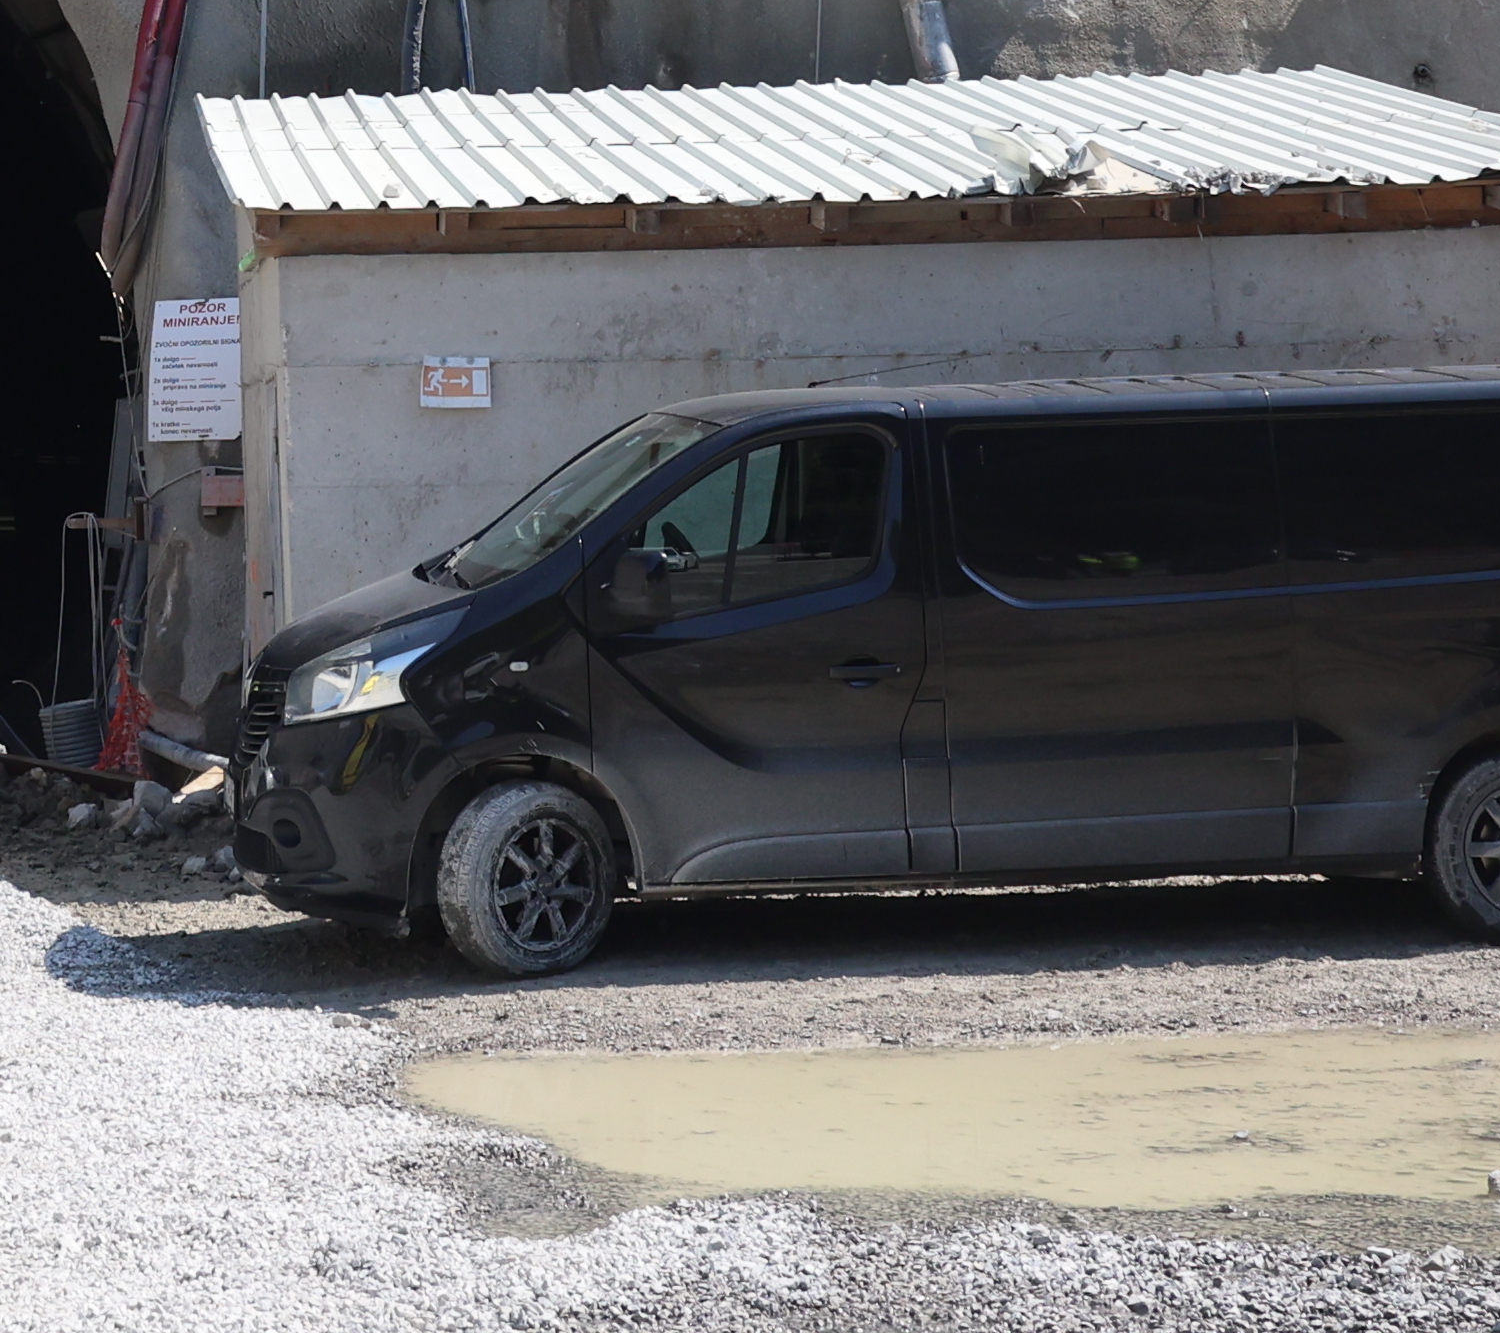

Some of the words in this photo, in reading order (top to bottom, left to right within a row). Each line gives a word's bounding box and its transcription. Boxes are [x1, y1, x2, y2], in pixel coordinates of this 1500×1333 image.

[179, 302, 226, 314] POZOR
[155, 339, 179, 348] ZVOČNI
[180, 338, 219, 347] OPOZORILNI
[198, 382, 227, 390] miniranje
[161, 398, 178, 406] dolgo
[161, 405, 174, 413] vžig
[206, 404, 221, 412] polja
